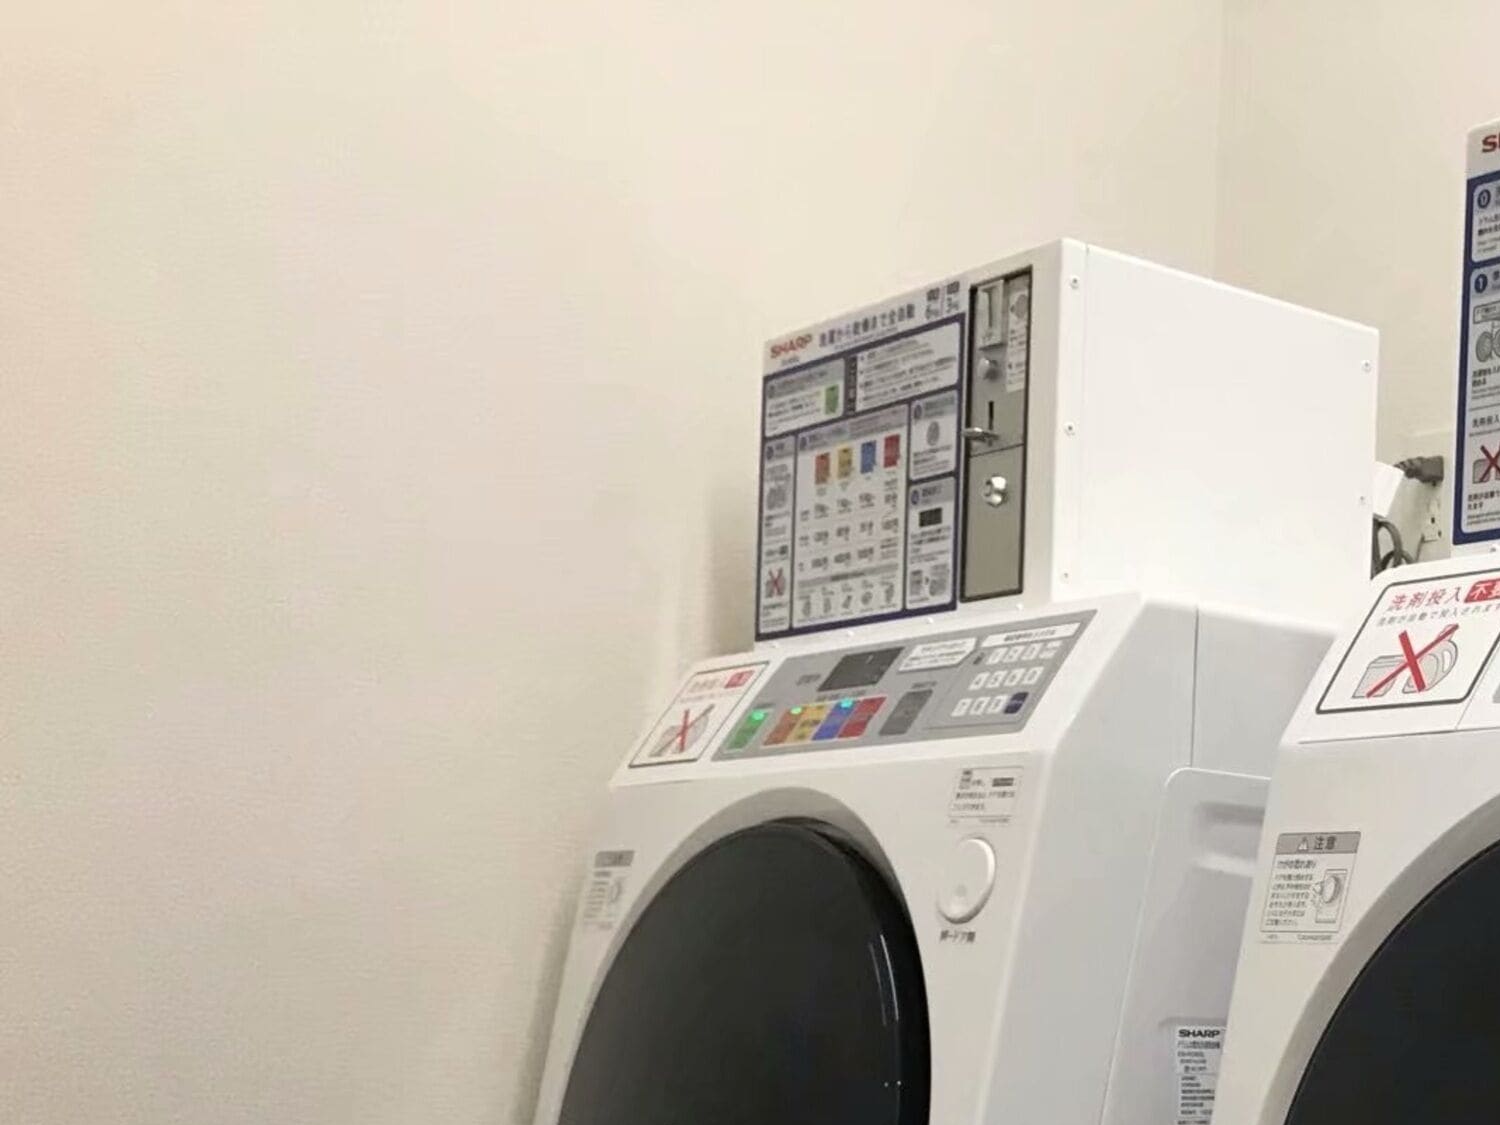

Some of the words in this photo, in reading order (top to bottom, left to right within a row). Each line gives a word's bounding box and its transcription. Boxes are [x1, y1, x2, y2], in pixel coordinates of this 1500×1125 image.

[770, 333, 813, 359] SHARP
[1386, 586, 1461, 611] 洗剤投入
[1178, 1029, 1221, 1038] SHARP
